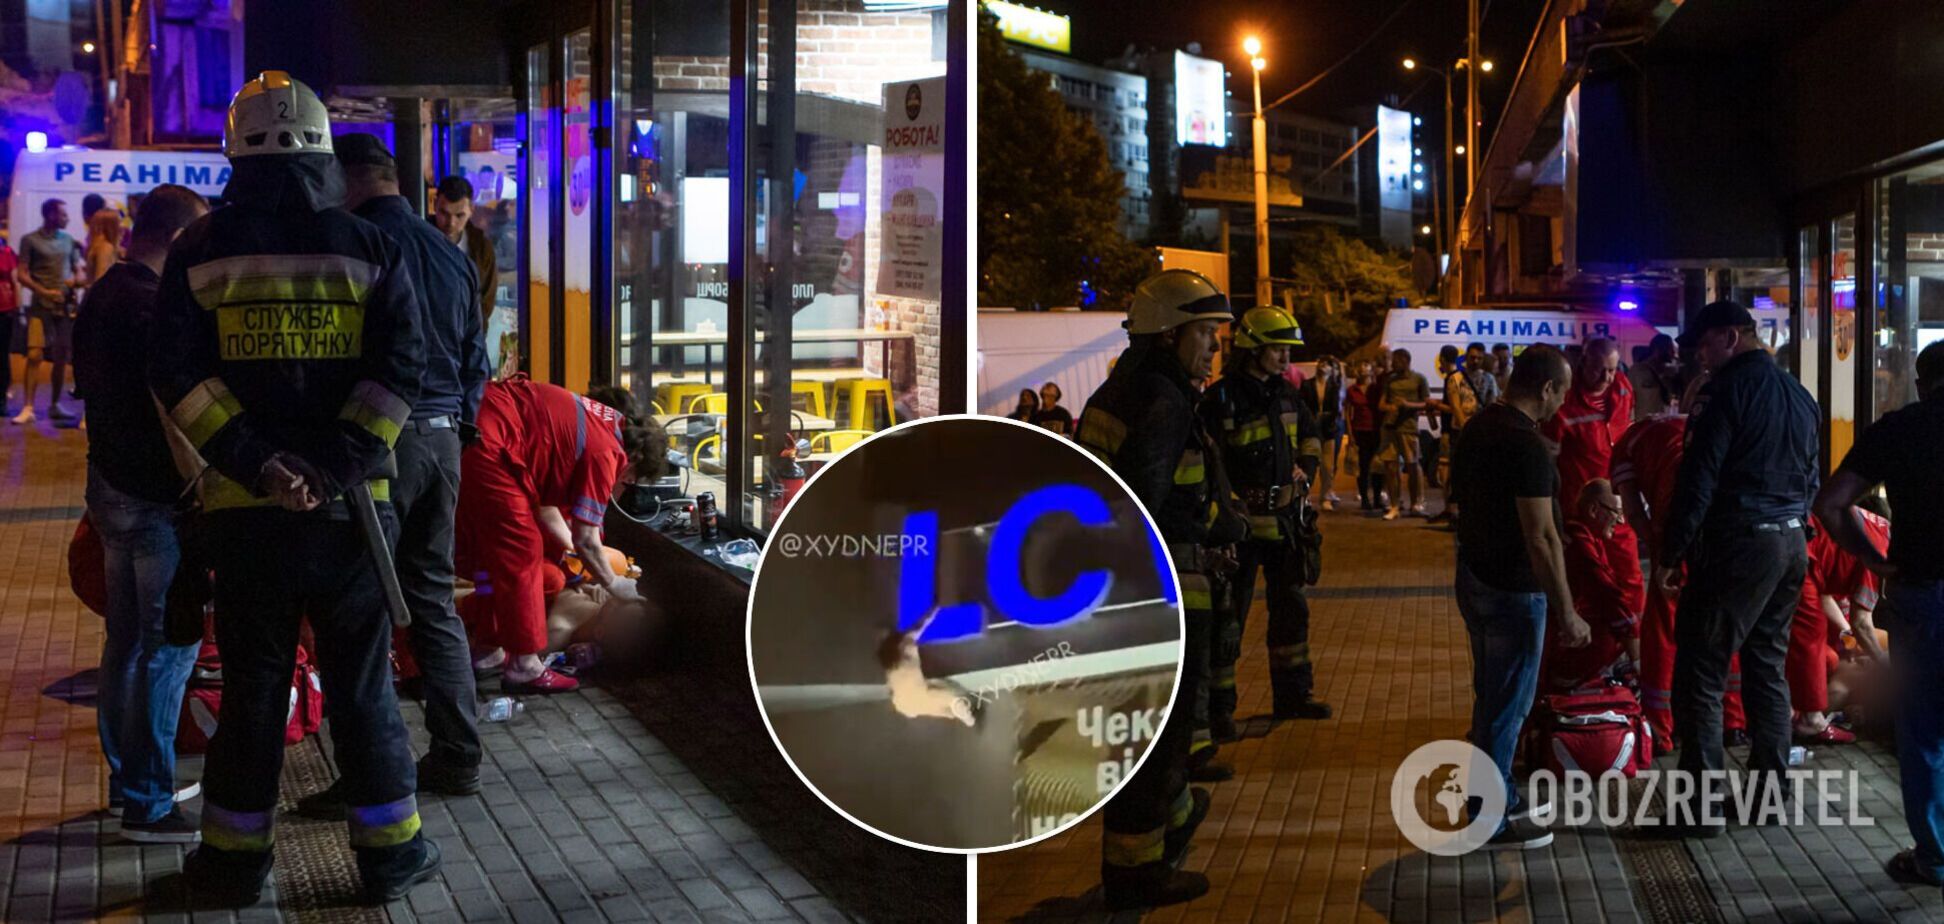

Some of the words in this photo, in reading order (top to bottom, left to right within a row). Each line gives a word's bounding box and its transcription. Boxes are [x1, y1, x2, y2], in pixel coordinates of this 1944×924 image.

[278, 101, 289, 119] 2
[885, 125, 940, 147] РОБОТА!
[244, 305, 337, 331] СЛУЖБА
[1414, 318, 1611, 341] РЕАНІМАЦІЯ
[226, 332, 353, 357] ПОРЯТУНКУ
[1077, 705, 1171, 748] Чек
